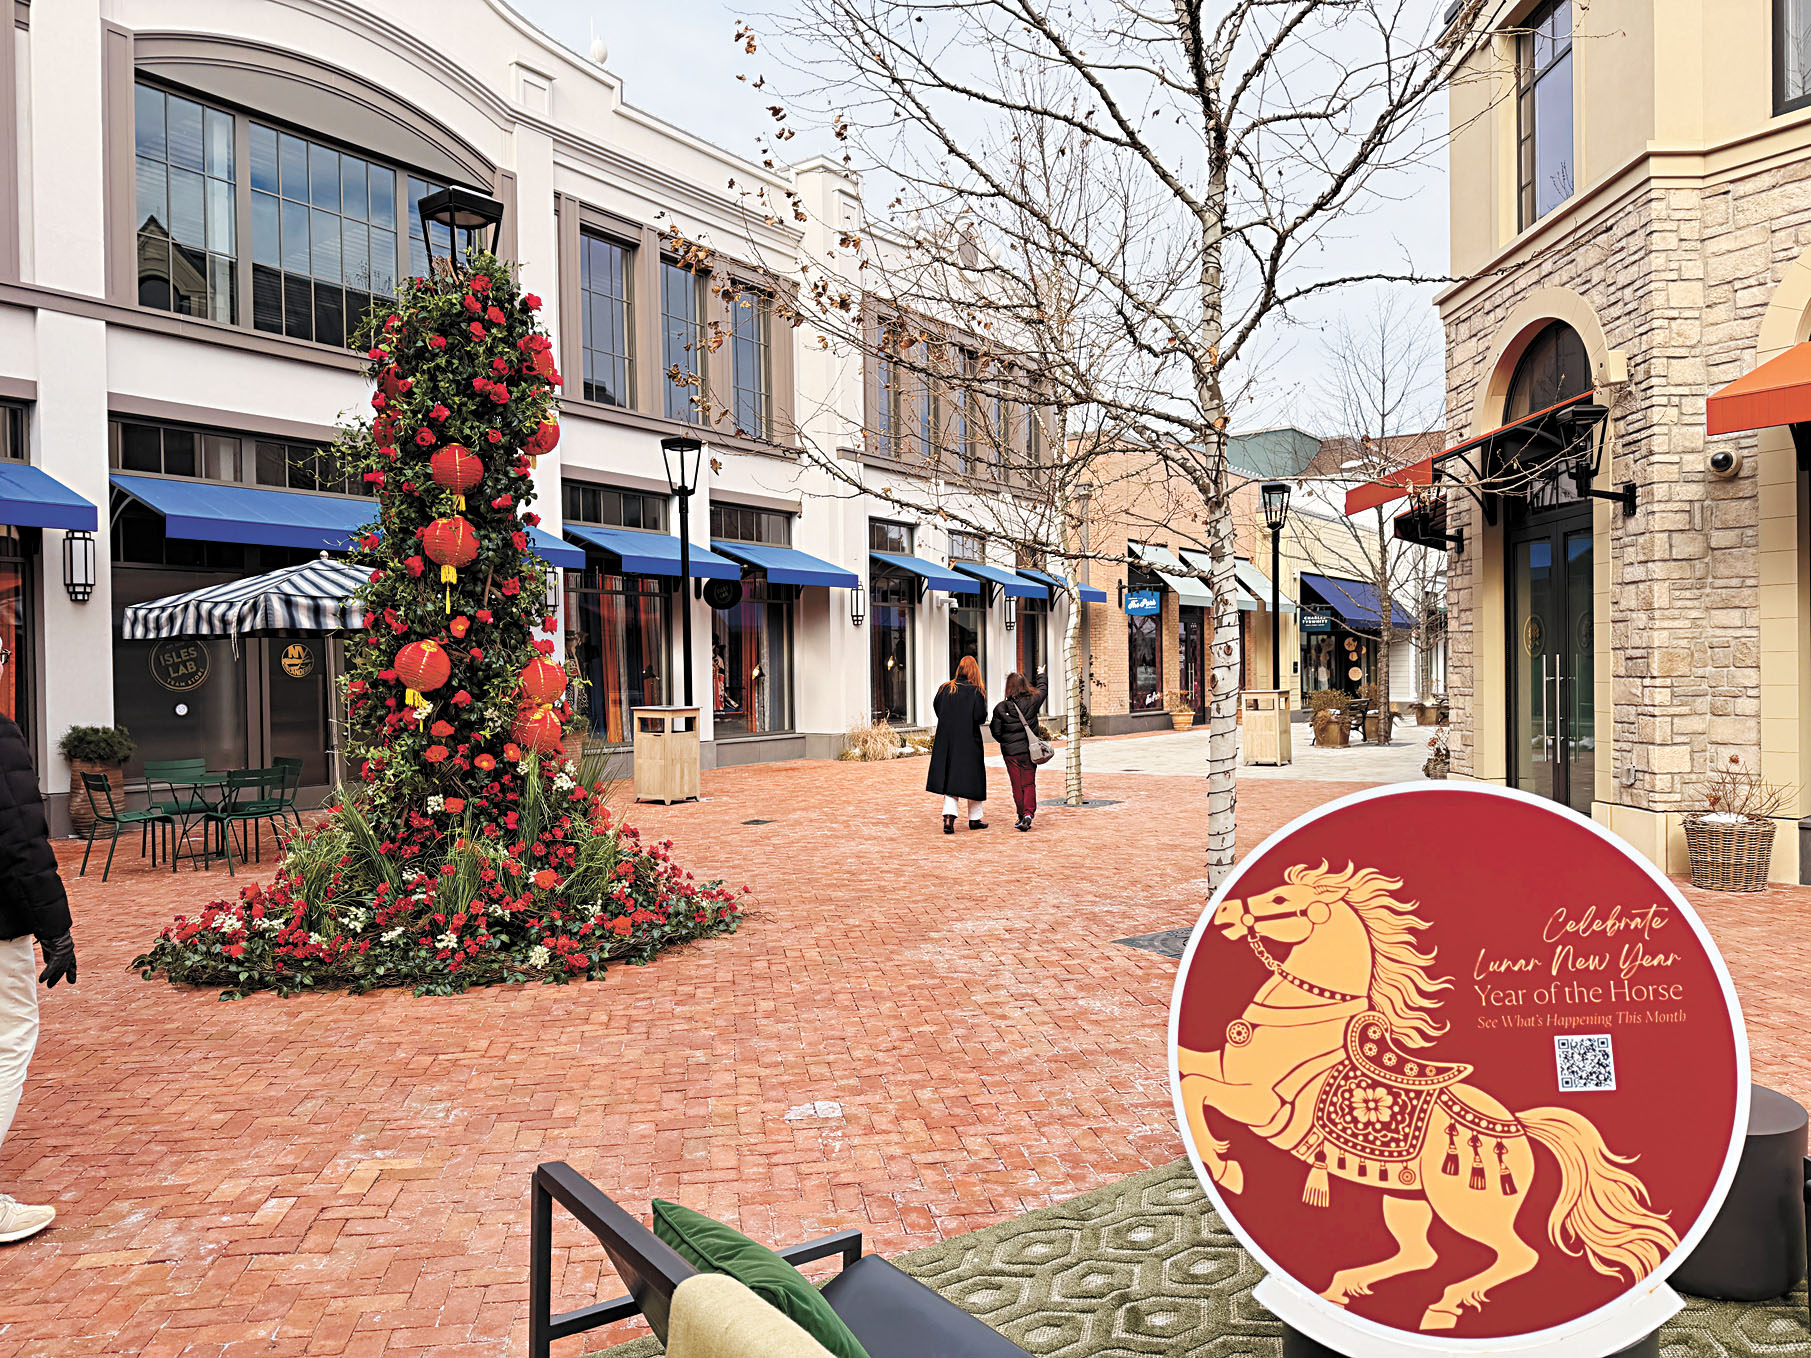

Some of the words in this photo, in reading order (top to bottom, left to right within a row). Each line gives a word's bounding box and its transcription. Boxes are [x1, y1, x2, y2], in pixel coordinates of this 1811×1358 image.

[159, 647, 198, 666] ISLES
[167, 678, 186, 687] TEAM
[187, 667, 205, 685] STORE
[168, 661, 197, 678] LAB
[1543, 903, 1669, 943] Celebrate
[1473, 948, 1542, 980] Lunar
[1551, 944, 1610, 976] New
[1619, 942, 1682, 979] Year
[1474, 985, 1527, 1006] Year
[1533, 981, 1561, 1005] of
[1564, 980, 1603, 1004] the
[1609, 979, 1684, 1002] Horse
[1477, 1016, 1498, 1029] See
[1501, 1013, 1544, 1028] What's
[1546, 1013, 1613, 1029] Happening
[1615, 1011, 1643, 1024] This
[1645, 1009, 1687, 1024] Month
